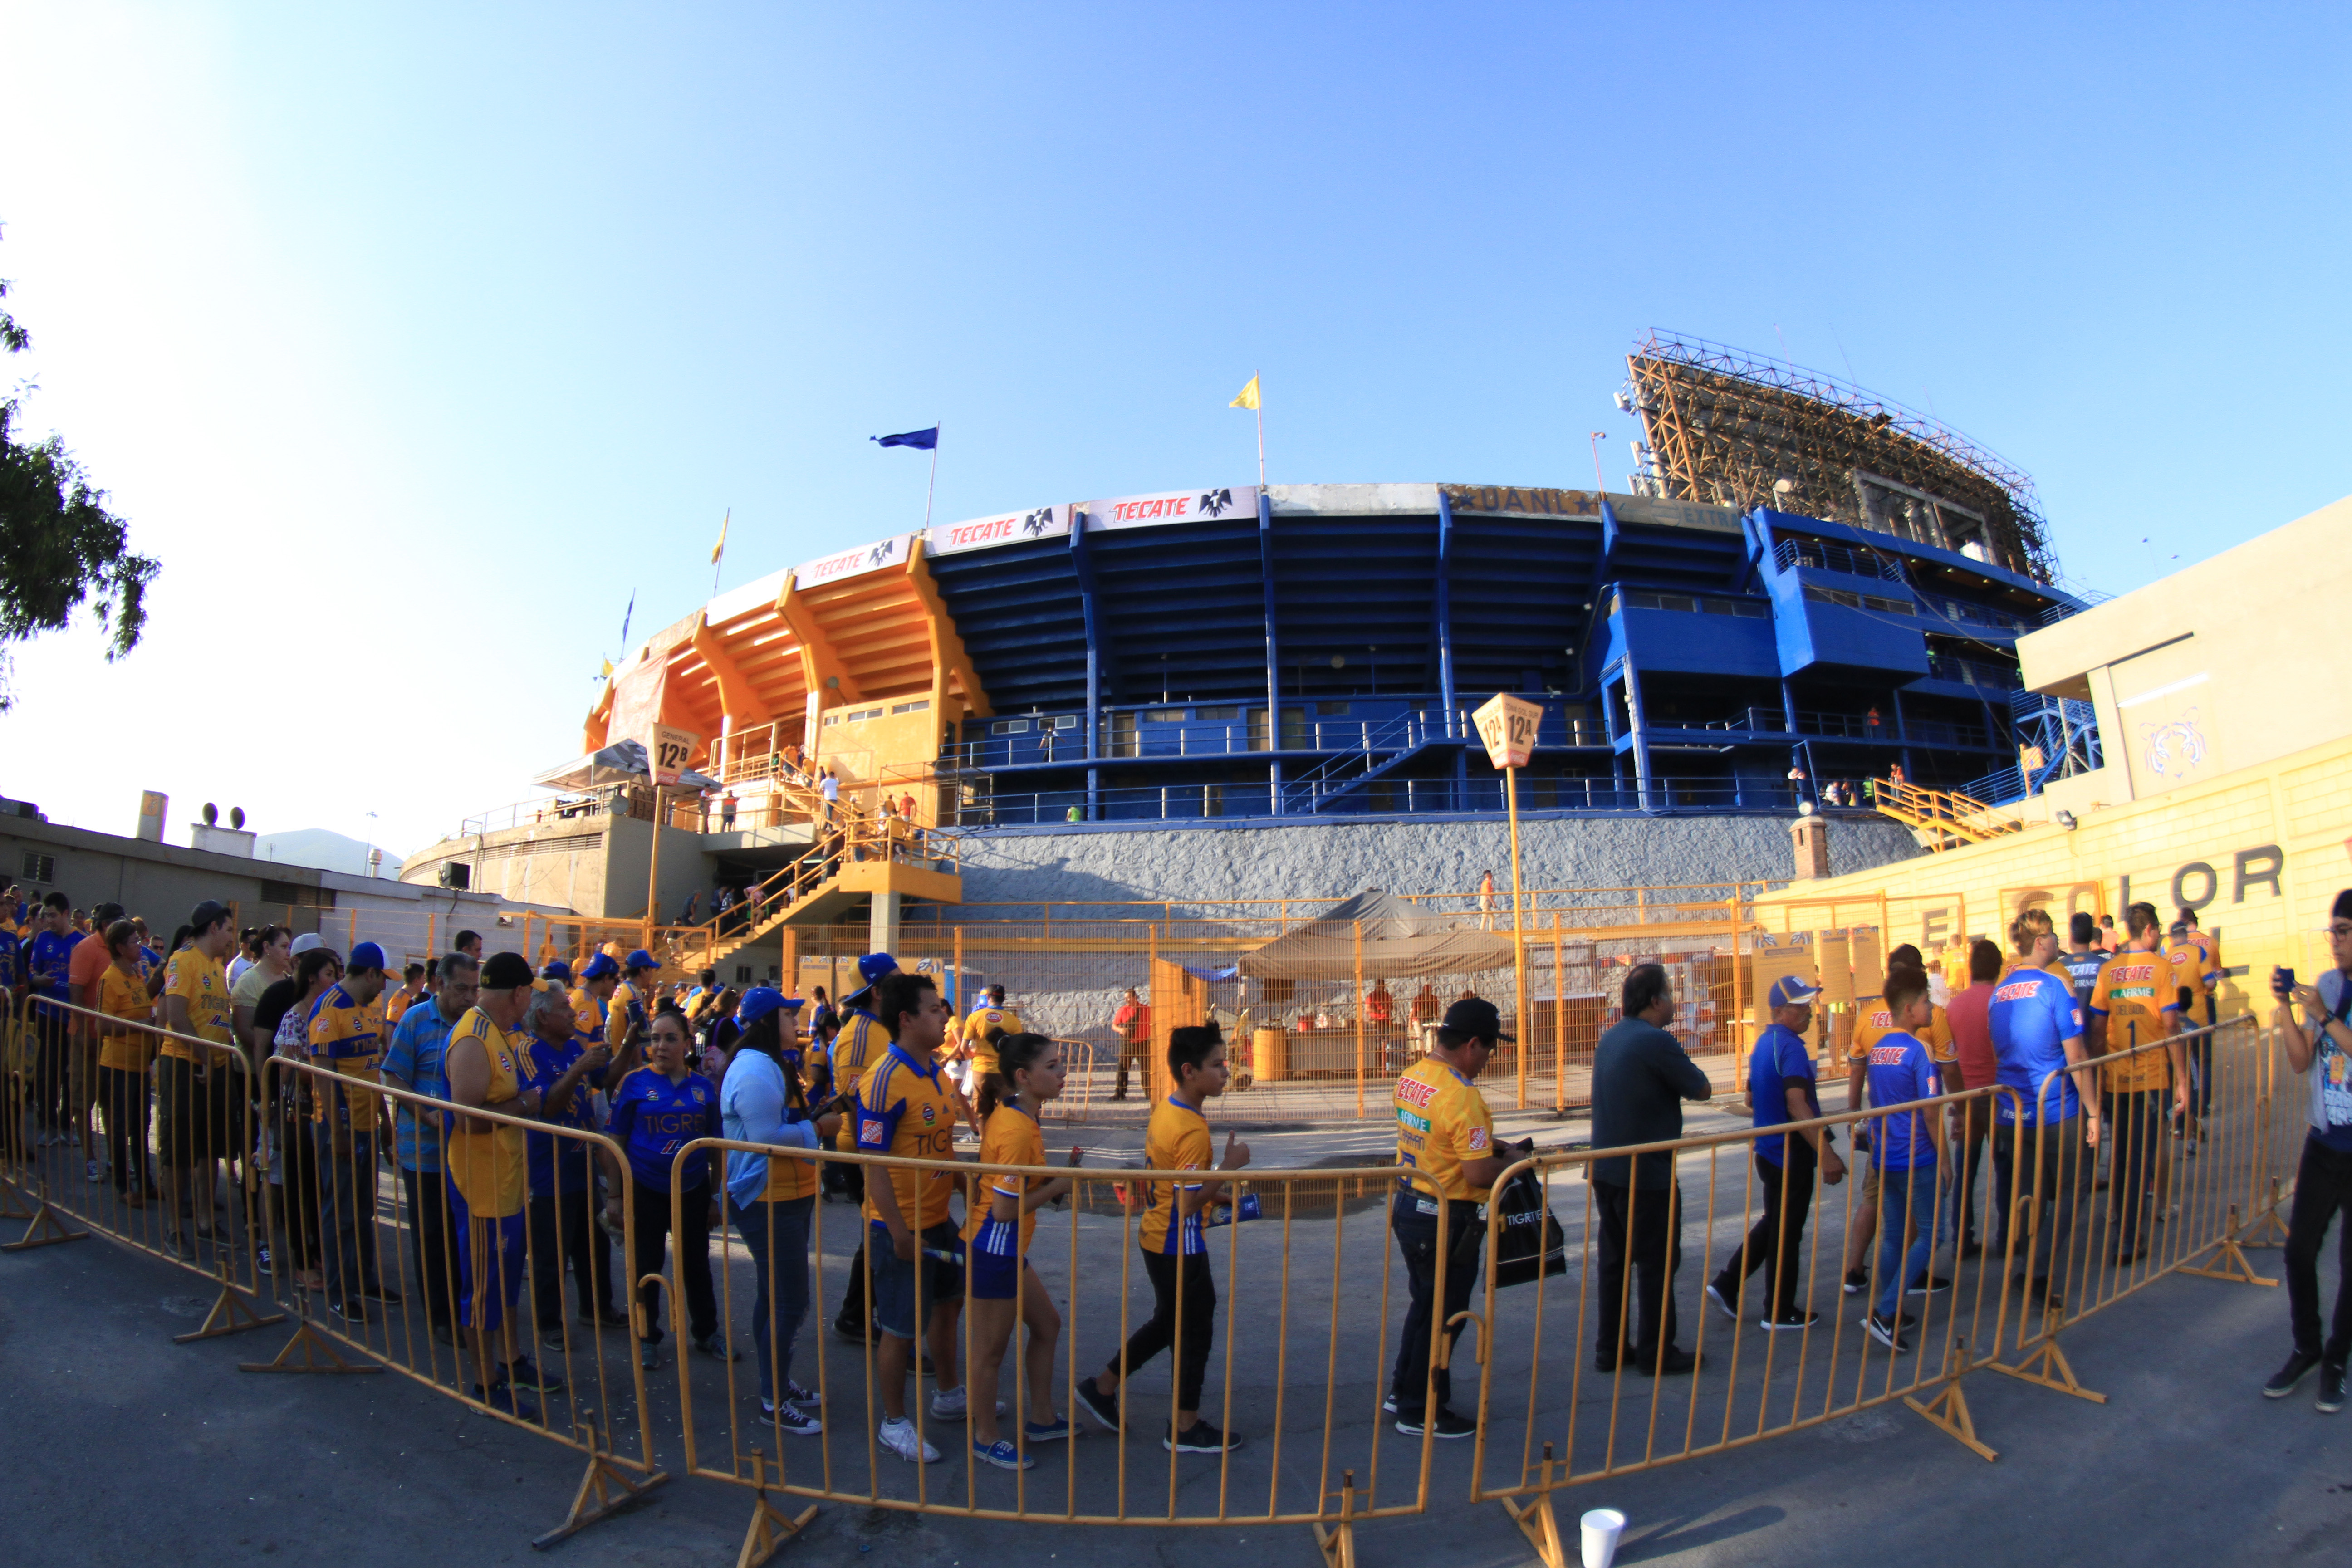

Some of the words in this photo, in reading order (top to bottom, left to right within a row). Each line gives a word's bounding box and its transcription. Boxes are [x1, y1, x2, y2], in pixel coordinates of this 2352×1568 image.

[1112, 497, 1191, 522] TECATE
[1480, 488, 1568, 514] UANL
[1682, 506, 1742, 530] EXTRA
[949, 518, 1017, 545] TECATE
[813, 551, 866, 579] TECATE
[662, 731, 690, 745] GENERAL
[2109, 965, 2155, 984] TECATE
[1994, 981, 2042, 1004] TECATE
[2120, 988, 2152, 998] AFIRME
[1867, 1047, 1909, 1066] TECATE
[1396, 1076, 1440, 1109] TECATE
